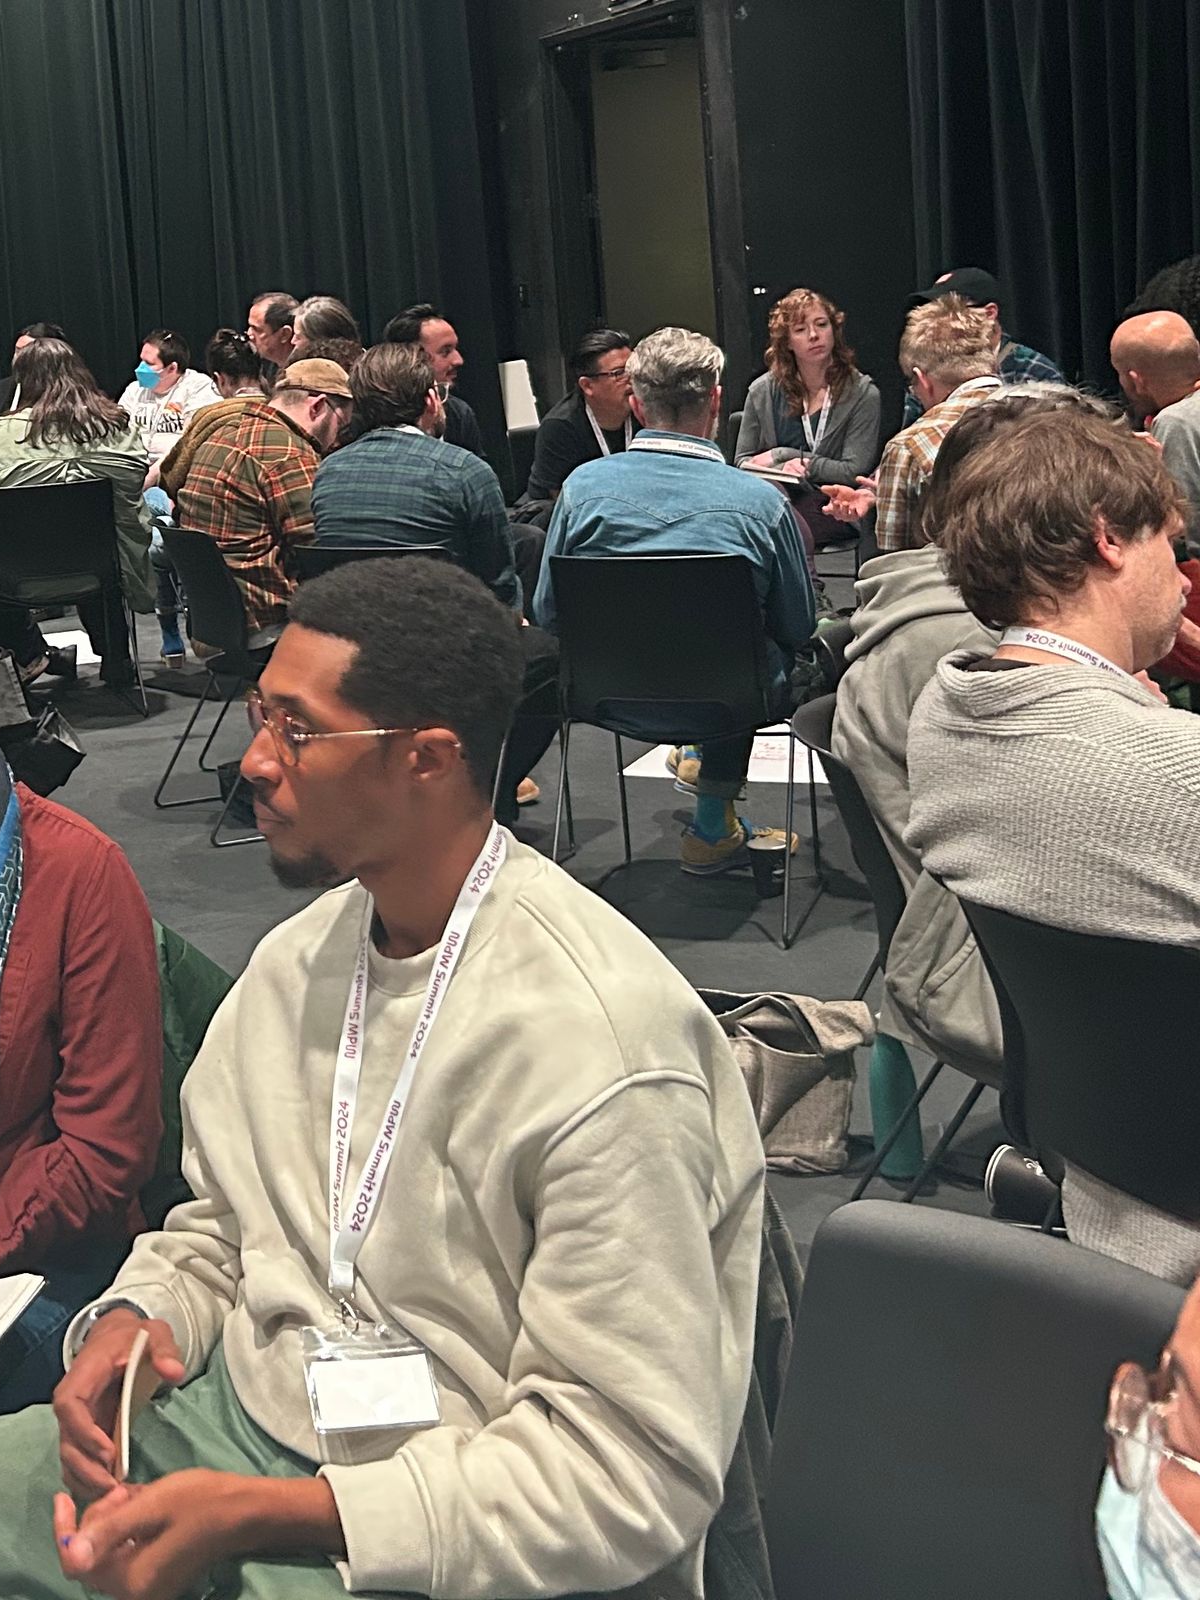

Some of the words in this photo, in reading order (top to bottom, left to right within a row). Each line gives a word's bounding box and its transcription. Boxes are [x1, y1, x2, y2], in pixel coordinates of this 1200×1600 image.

[1025, 632, 1057, 649] 2024
[1058, 641, 1099, 666] Summit
[468, 860, 495, 893] 2024
[349, 974, 363, 1021] Summit
[423, 969, 446, 1021] Summit
[409, 1021, 429, 1058] 2024
[336, 1100, 349, 1139] 2024
[333, 1140, 345, 1192] Summit
[363, 1140, 390, 1192] Summit
[349, 1192, 372, 1233] 2024
